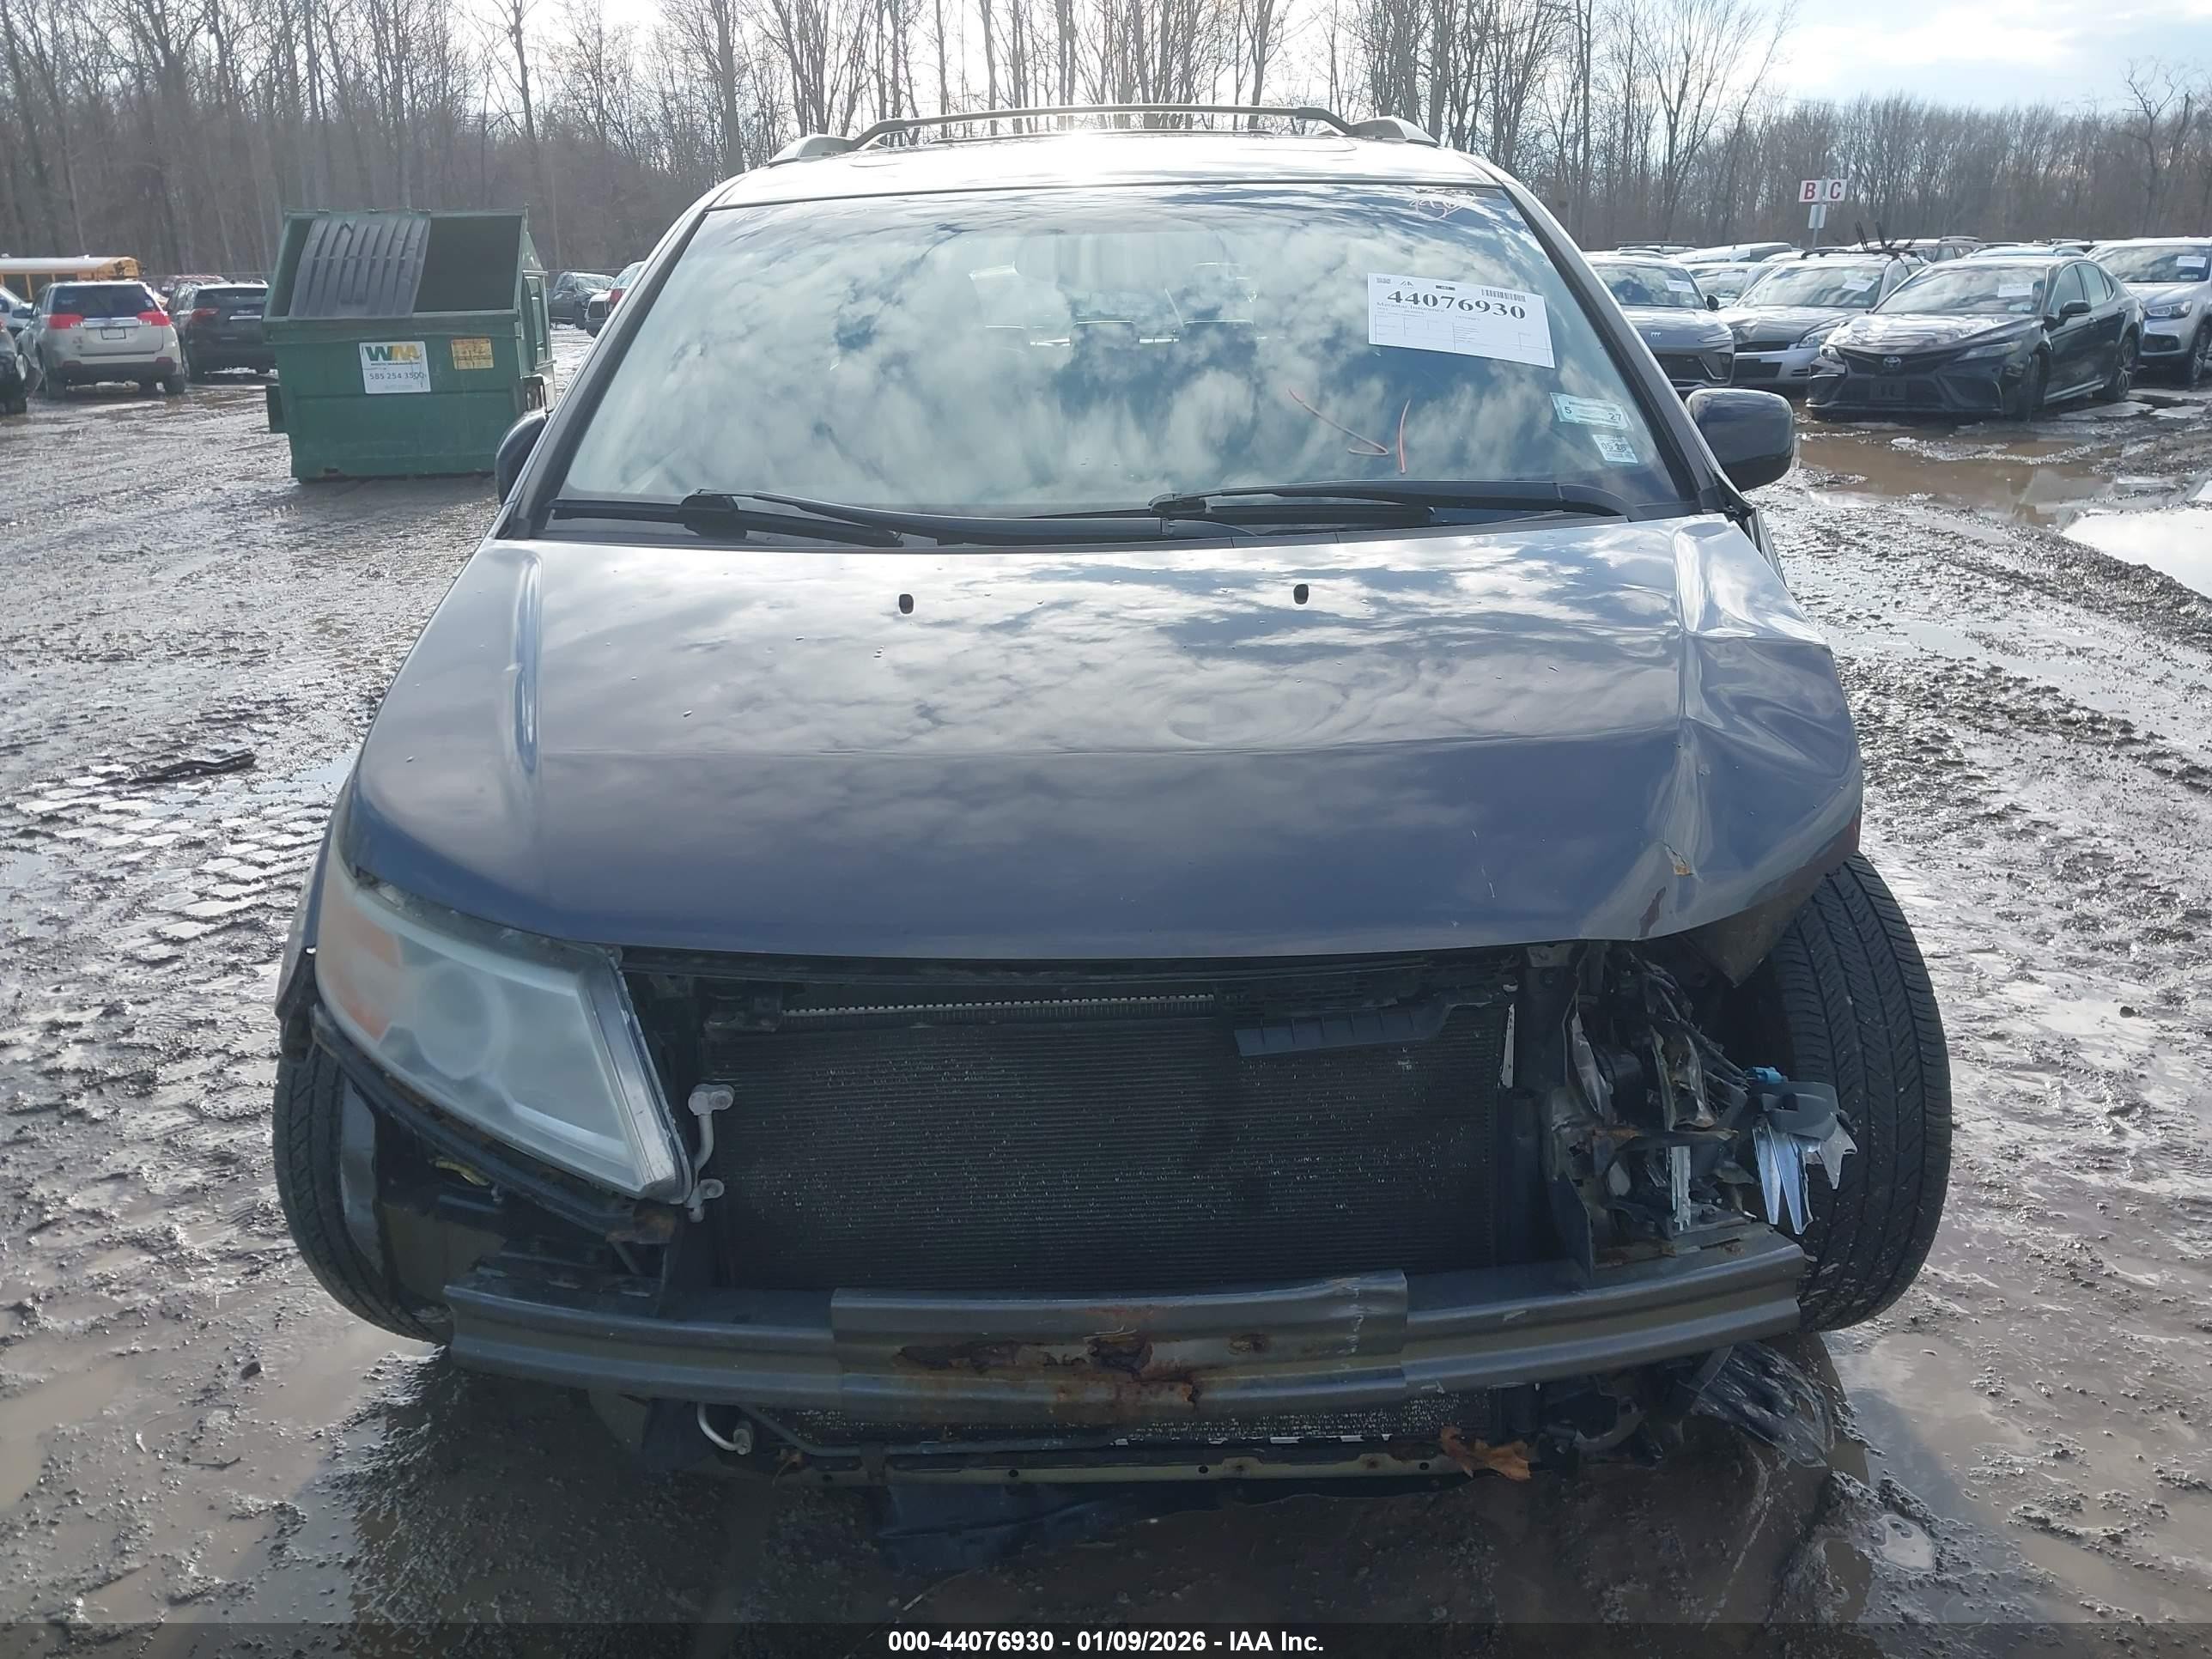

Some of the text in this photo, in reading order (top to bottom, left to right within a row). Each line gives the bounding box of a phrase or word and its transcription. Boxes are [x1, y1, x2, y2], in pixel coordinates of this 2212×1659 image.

[1804, 182, 1816, 199] B
[1830, 181, 1841, 199] C
[1387, 289, 1526, 319] 44076930
[365, 345, 421, 362] WM
[1565, 405, 1572, 415] 5
[1608, 412, 1622, 422] 27
